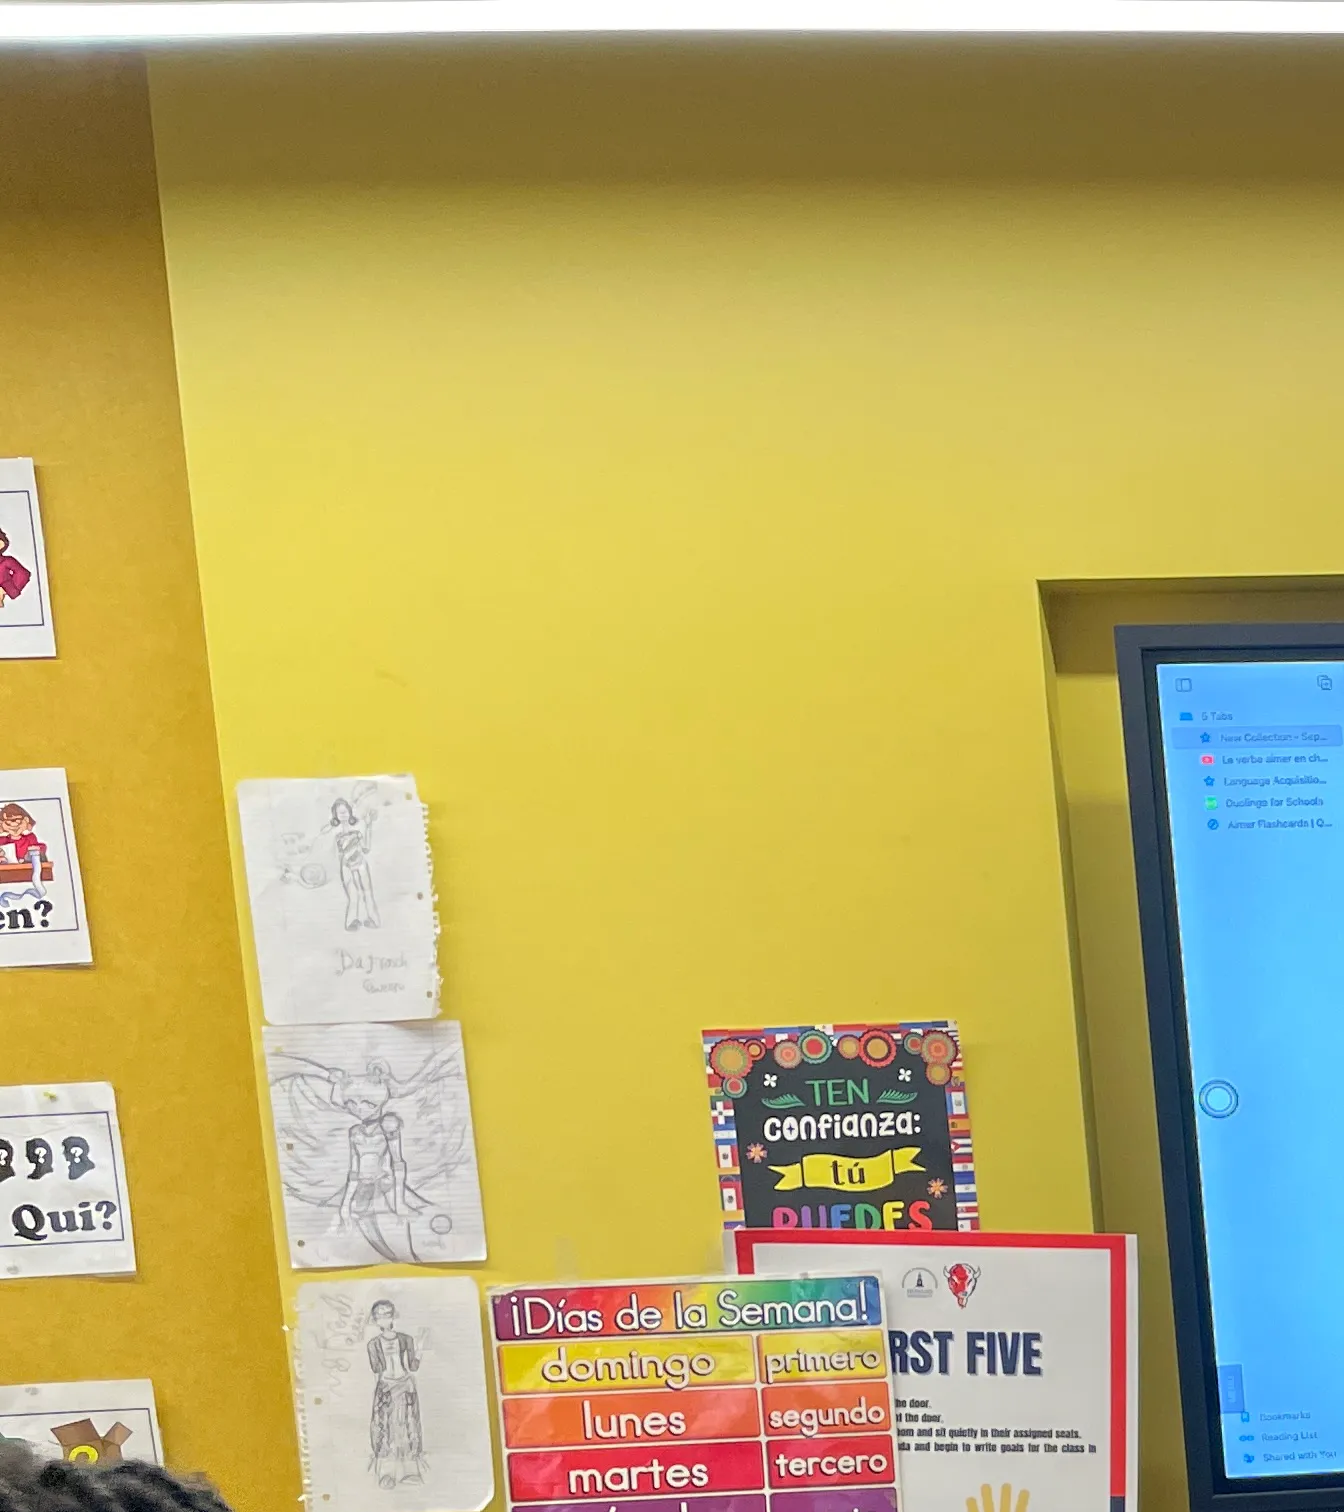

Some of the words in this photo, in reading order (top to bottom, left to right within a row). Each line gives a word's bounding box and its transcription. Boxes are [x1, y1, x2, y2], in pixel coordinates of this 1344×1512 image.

[805, 1078, 869, 1106] TEN
[831, 1160, 865, 1186] tú
[12, 1200, 118, 1240] Qui?
[510, 1296, 604, 1337] ¡Días
[615, 1290, 663, 1330] de
[674, 1286, 708, 1327] la
[719, 1280, 869, 1327] Semana!
[540, 1341, 716, 1391] domingo
[763, 1343, 882, 1385] primero
[888, 1330, 954, 1374] RST
[966, 1331, 1043, 1376] FIVE
[583, 1400, 688, 1441] lunes
[768, 1396, 886, 1438] segundo
[917, 1428, 932, 1437] and
[949, 1428, 977, 1439] quietly
[991, 1428, 1011, 1437] their
[1014, 1429, 1052, 1440] assigned
[1055, 1429, 1082, 1439] seats.
[568, 1457, 710, 1493] martes
[775, 1449, 887, 1478] tercero
